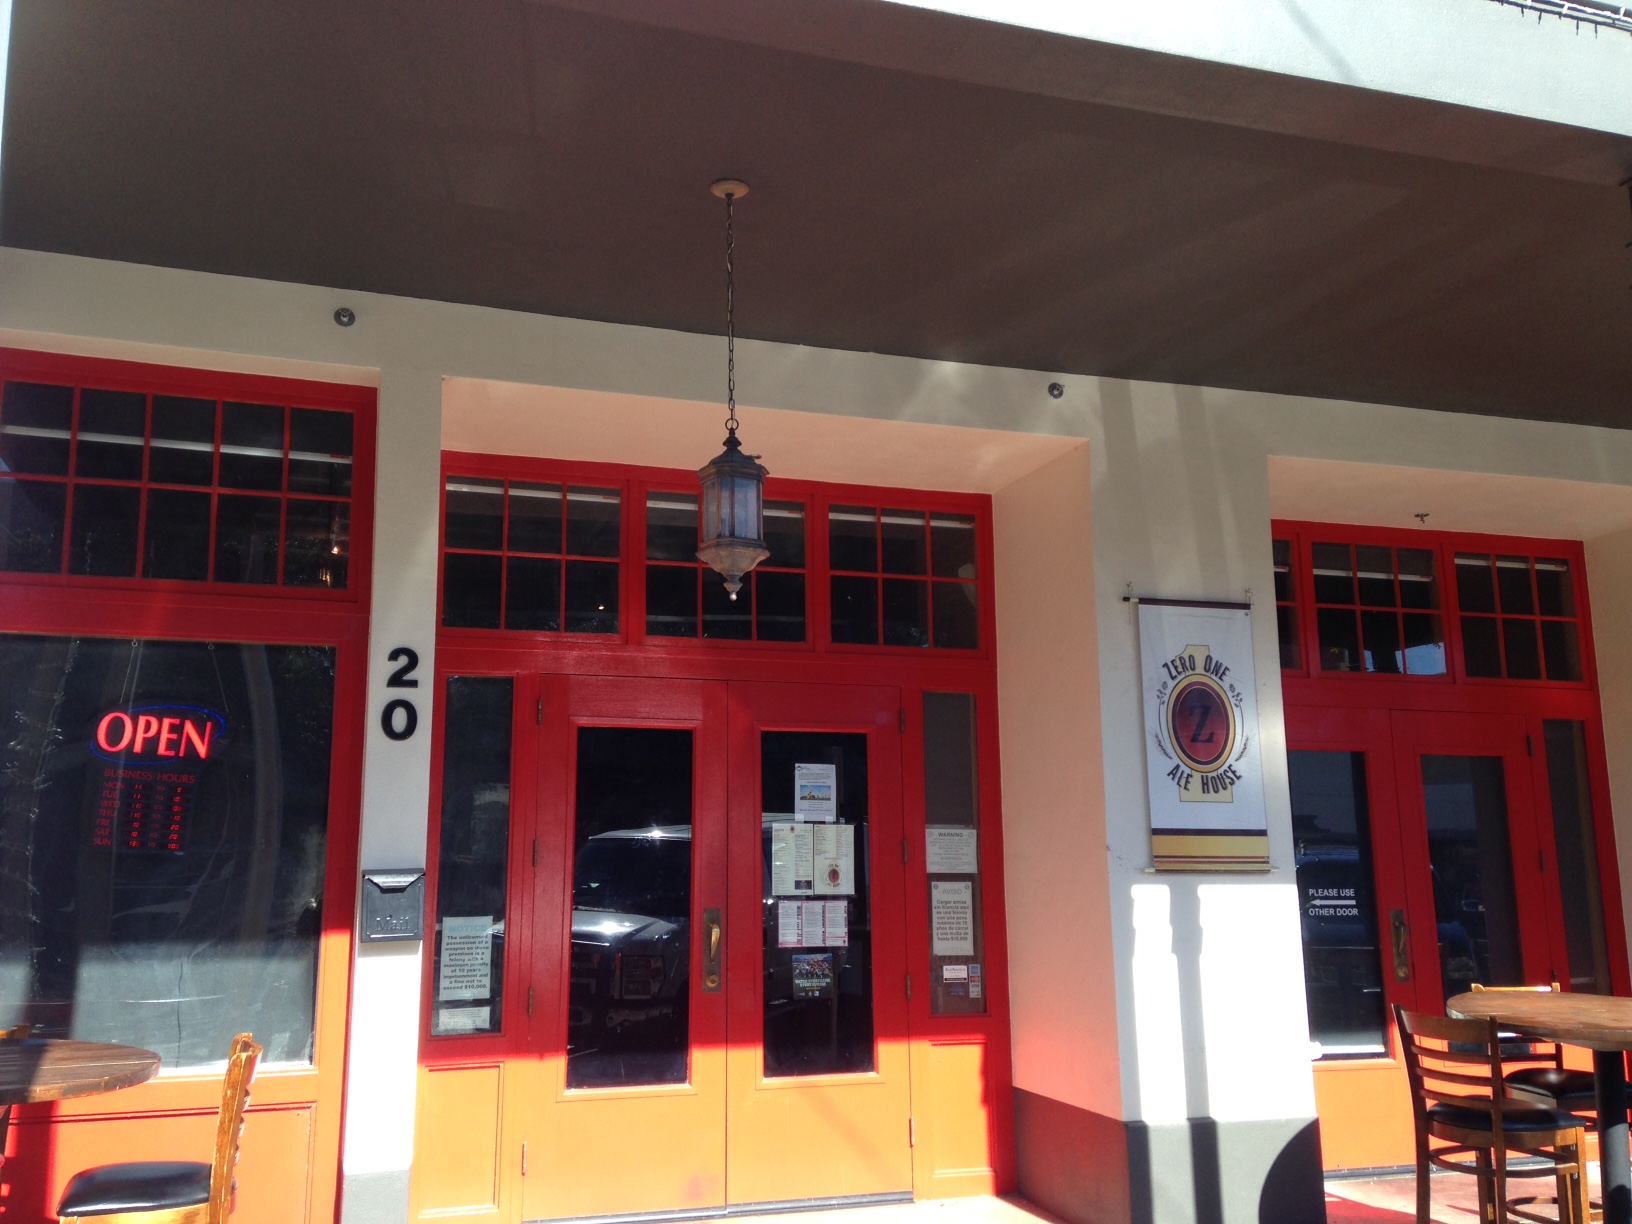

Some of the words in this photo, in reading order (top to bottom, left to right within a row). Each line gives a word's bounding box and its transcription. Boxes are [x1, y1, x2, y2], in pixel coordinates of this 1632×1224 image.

[1162, 654, 1196, 681] ZERO
[1204, 655, 1231, 682] ONE
[97, 712, 212, 759] OPEN
[1189, 704, 1214, 743] Z
[104, 769, 153, 780] BUSINESS
[157, 773, 195, 783] HOURS
[1167, 764, 1193, 791] ALE
[1201, 764, 1242, 794] HOUSE
[376, 916, 410, 931] Mail
